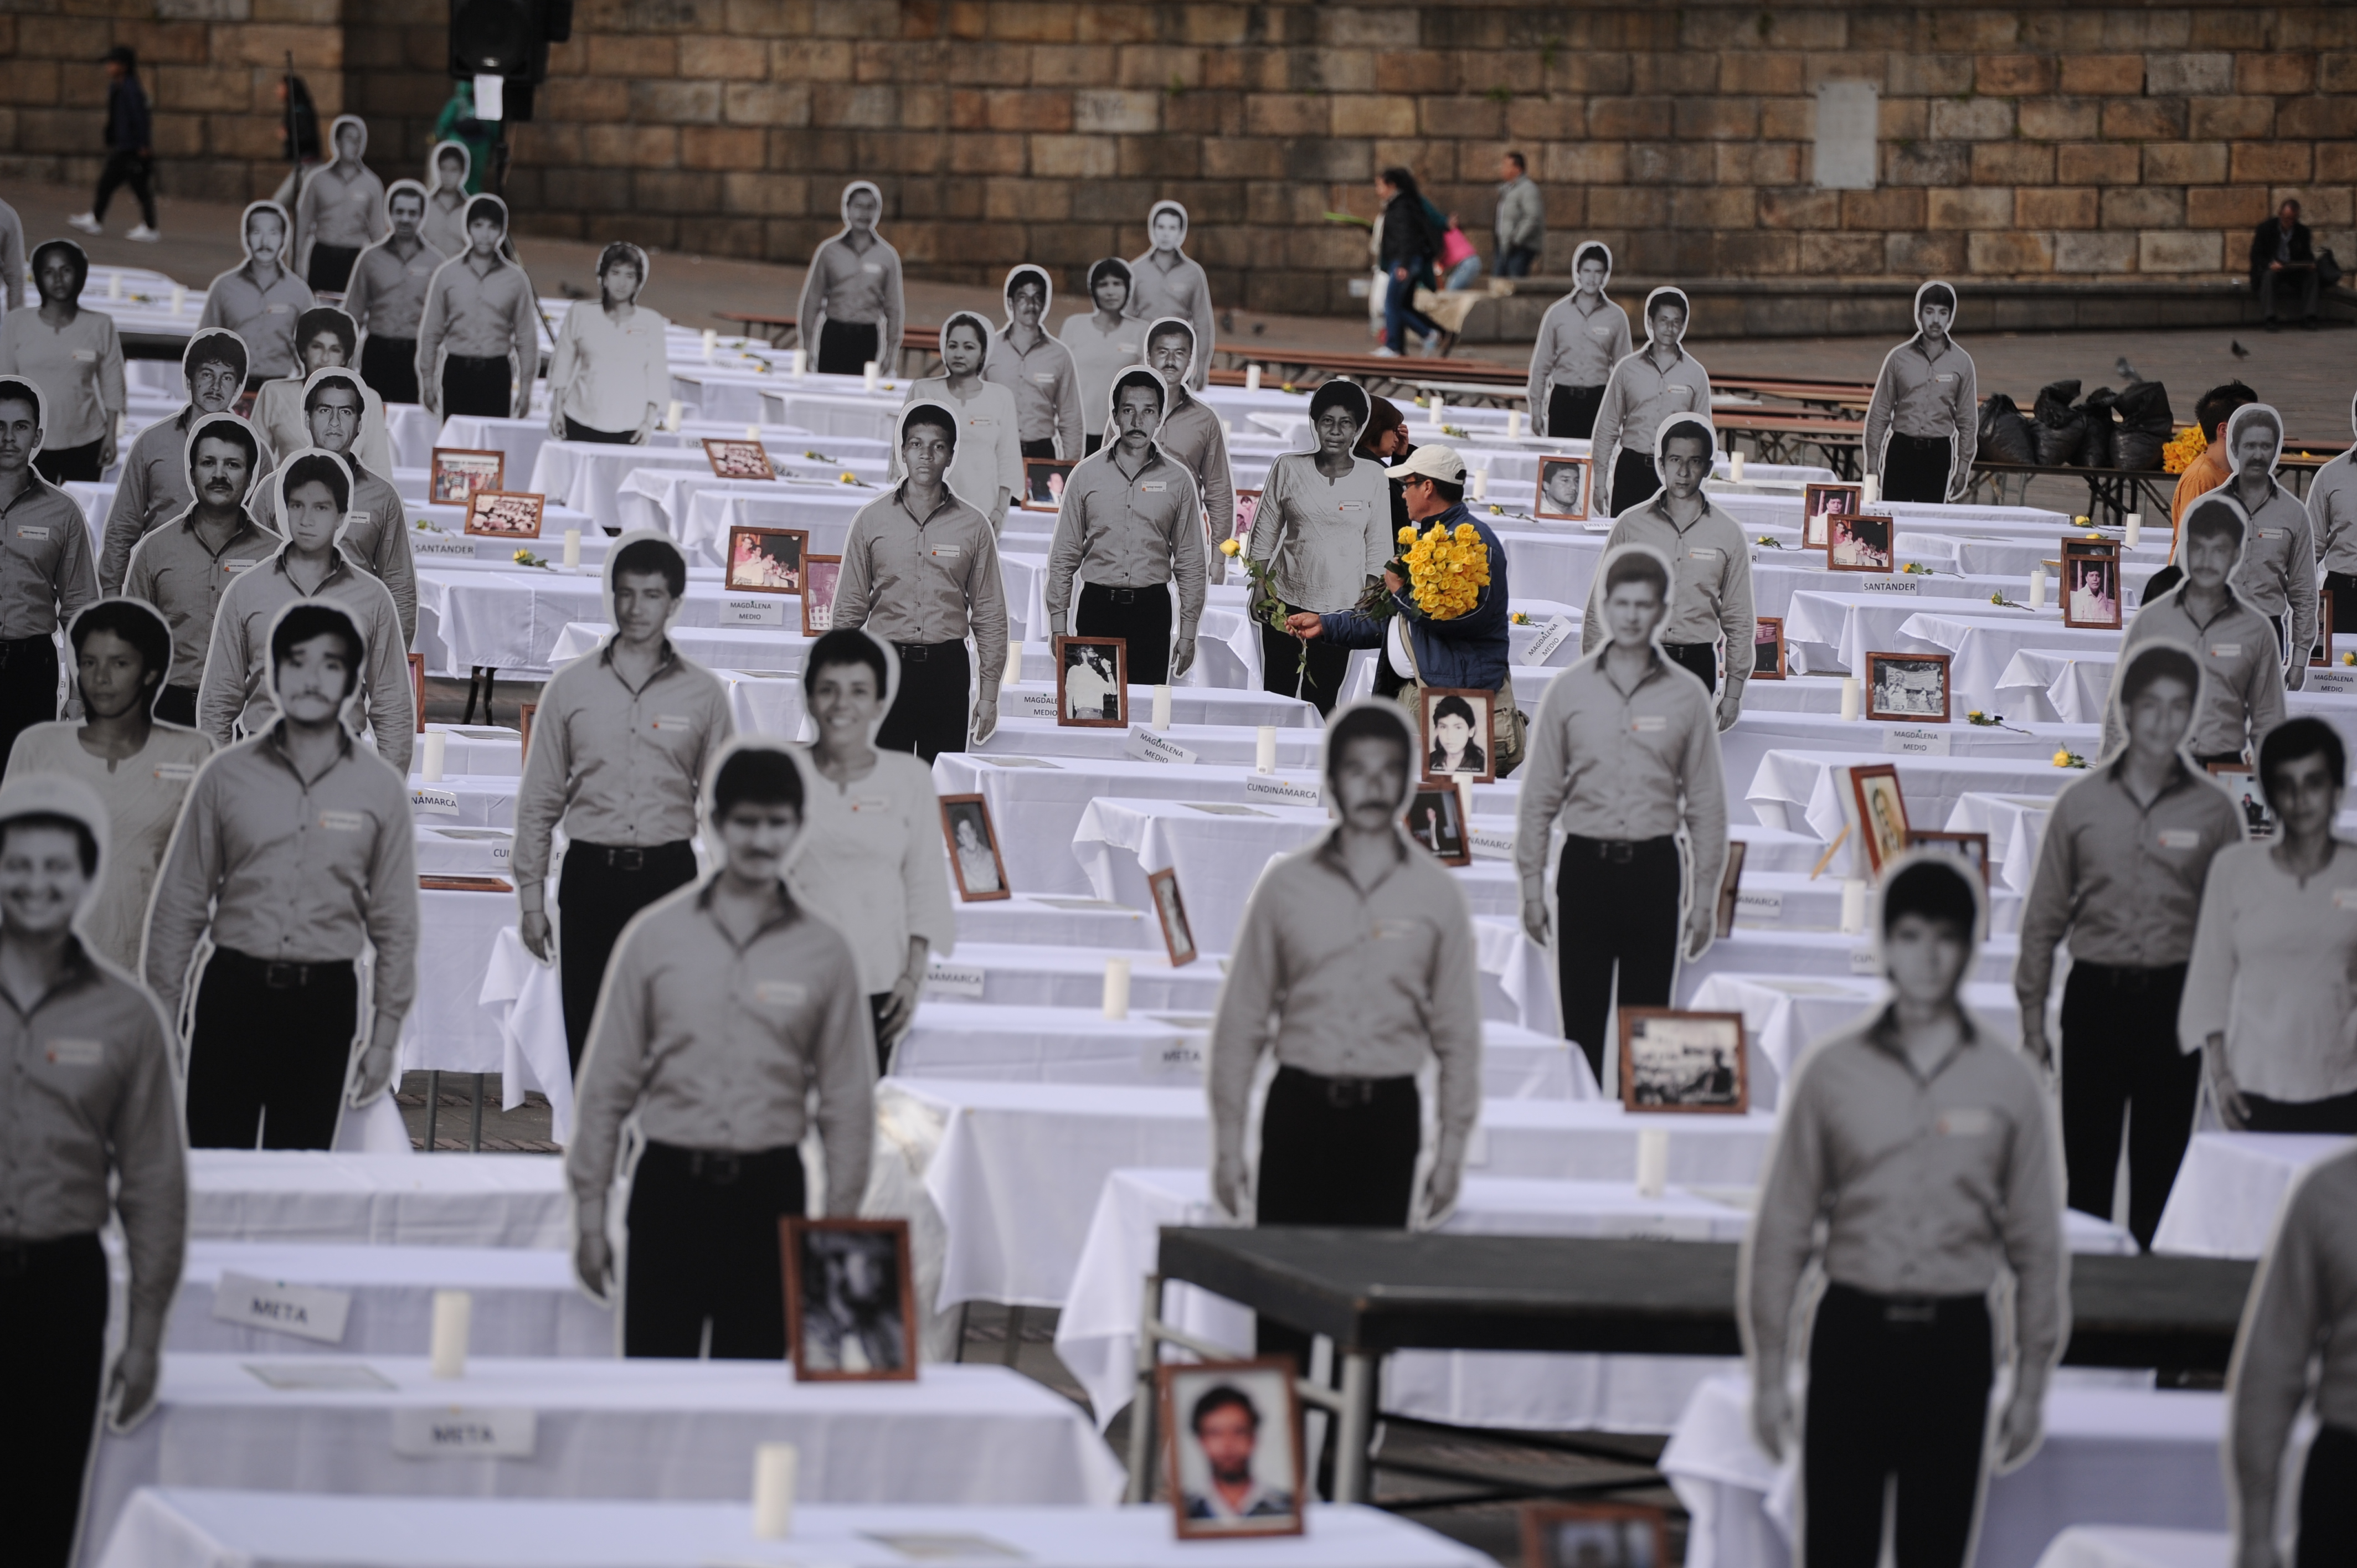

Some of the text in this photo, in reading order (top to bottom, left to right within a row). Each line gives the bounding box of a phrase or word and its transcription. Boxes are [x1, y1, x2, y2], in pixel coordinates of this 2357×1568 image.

[415, 544, 475, 554] SANTANDER
[1528, 623, 1558, 656] MAGDALENA
[1542, 638, 1560, 656] MEDIO
[2314, 674, 2354, 683] MAGDALENA
[1894, 731, 1938, 740] MAGDALENA
[1140, 733, 1183, 758] MAGDALENA
[1144, 749, 1169, 763] MEDIO
[1247, 783, 1317, 799] CUNDINAMARCA
[253, 1297, 307, 1324] META
[431, 1425, 496, 1445] META
